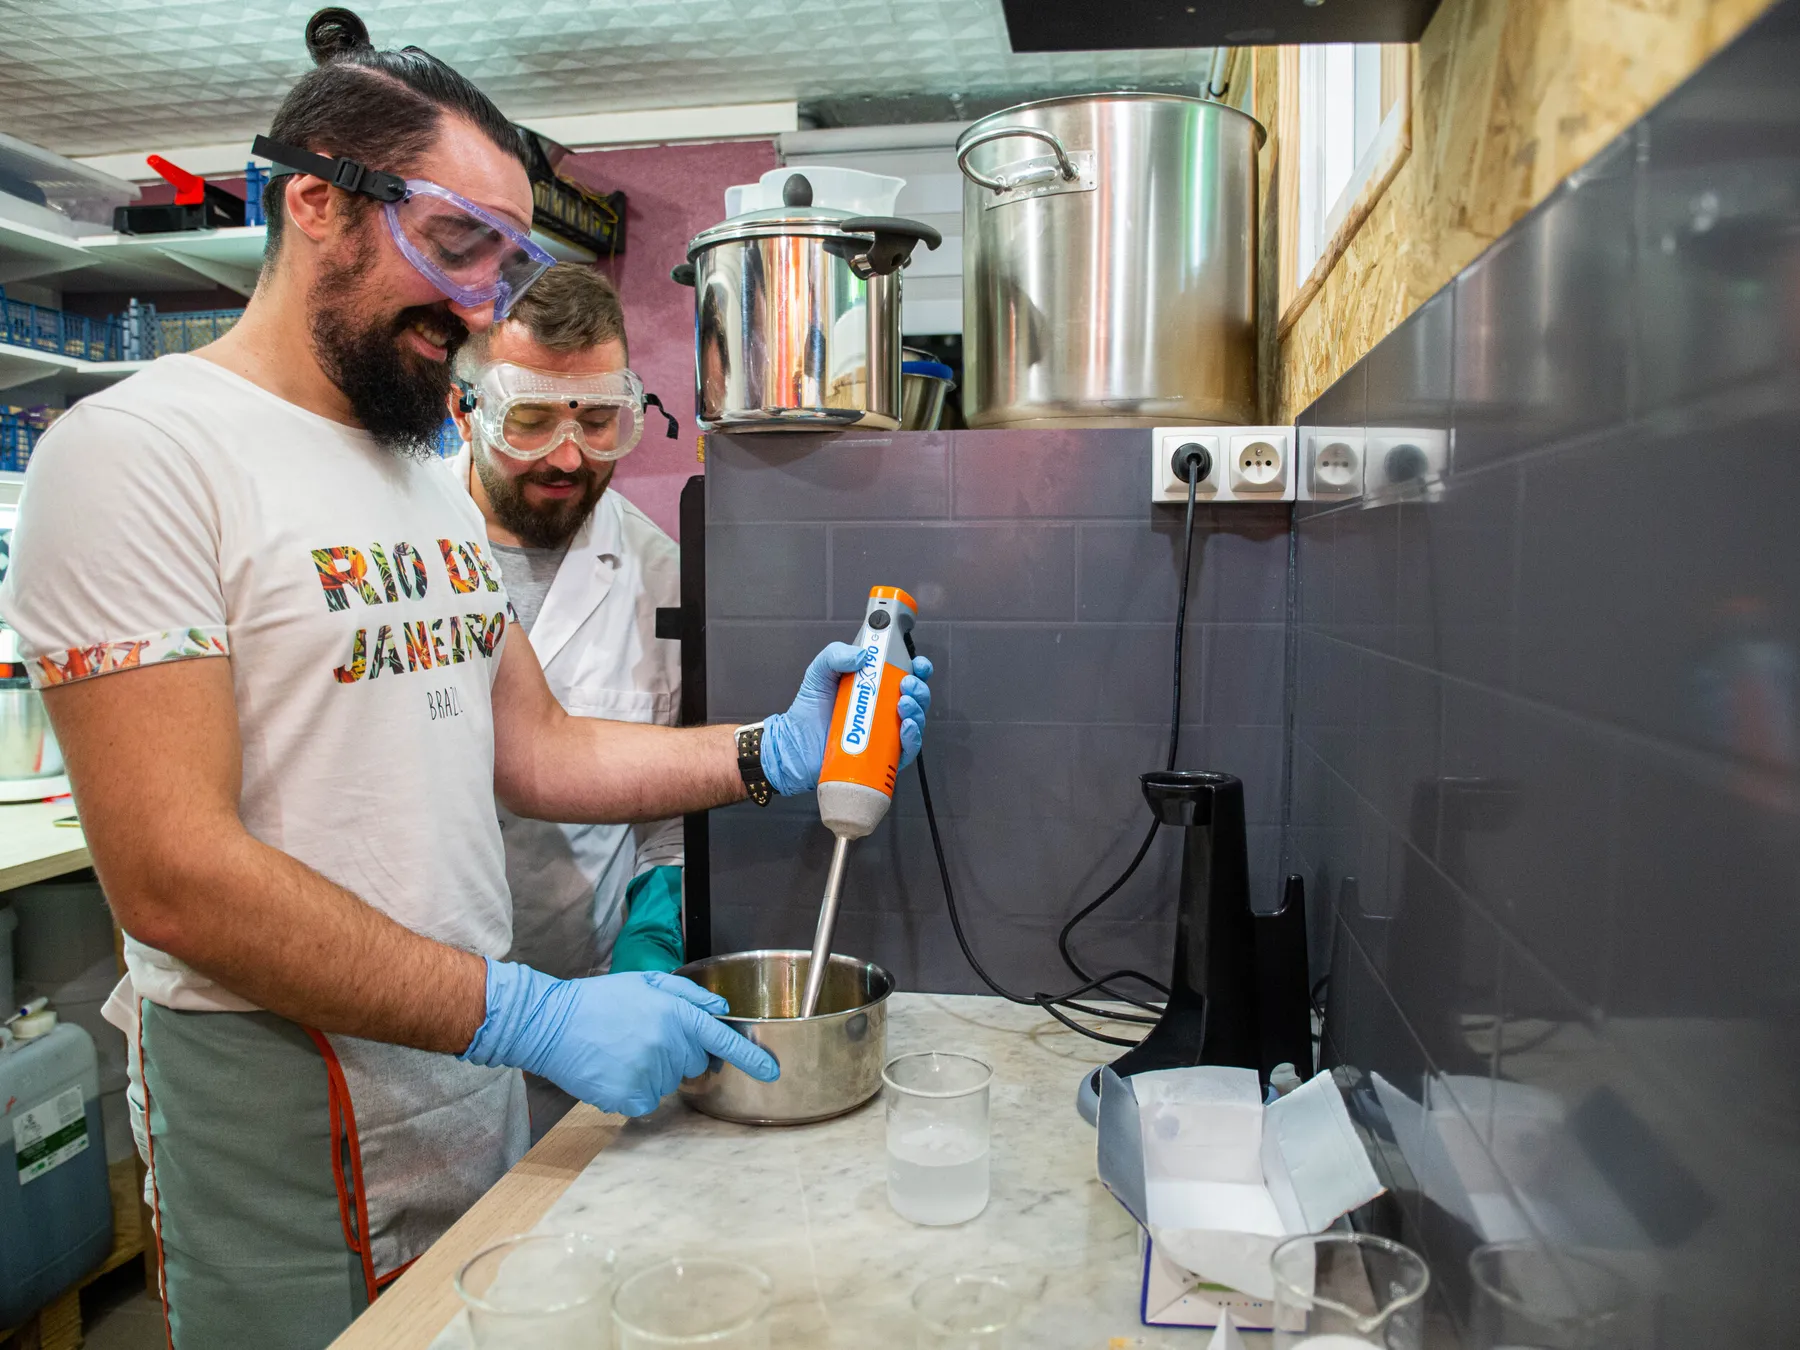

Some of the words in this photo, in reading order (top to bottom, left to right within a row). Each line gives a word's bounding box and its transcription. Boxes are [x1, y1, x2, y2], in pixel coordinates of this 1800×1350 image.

[310, 541, 428, 612] RIO
[436, 538, 501, 595] DE
[332, 611, 506, 684] JANEIRO
[864, 645, 879, 668] 190
